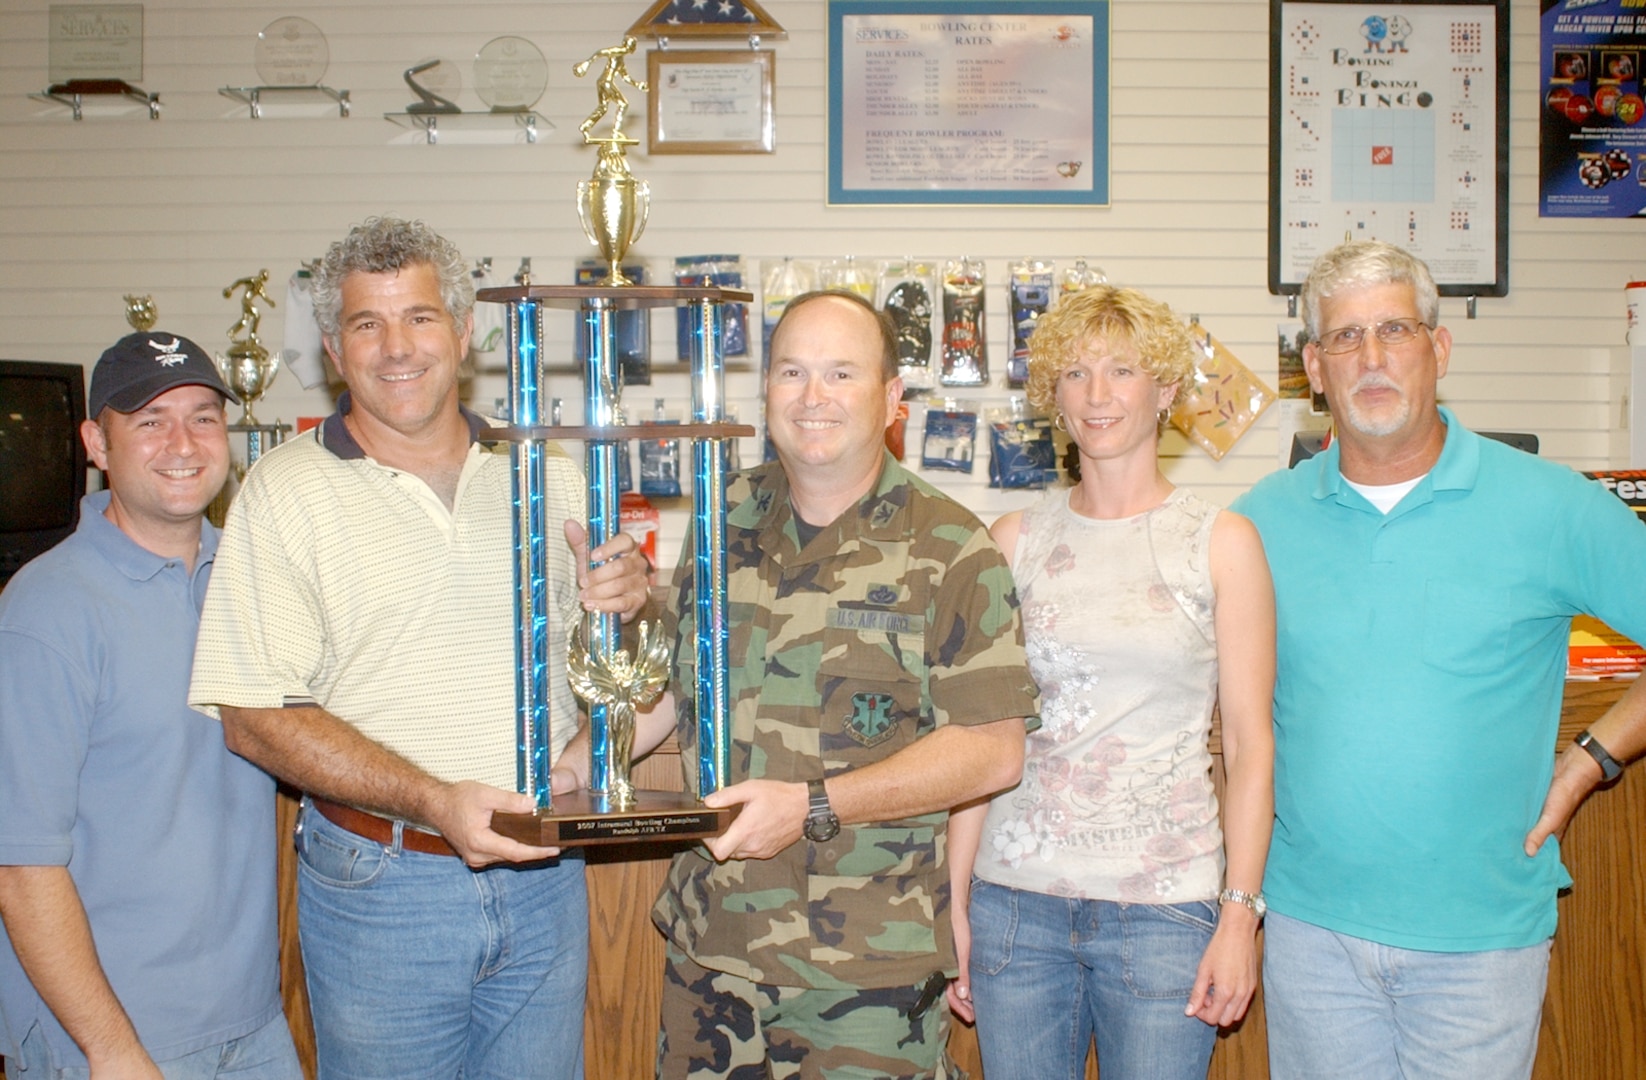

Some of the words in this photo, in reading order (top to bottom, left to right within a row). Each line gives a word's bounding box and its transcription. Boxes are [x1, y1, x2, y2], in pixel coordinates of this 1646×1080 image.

[920, 22, 976, 32] BOWLING
[980, 22, 1027, 32] CENTER
[856, 28, 909, 40] SERVICES
[955, 36, 993, 46] RATES
[1330, 48, 1394, 66] BOWLING
[1334, 88, 1434, 108] BINGO
[1620, 103, 1636, 114] 24
[837, 611, 856, 626] U.S.
[858, 612, 877, 630] AIR
[879, 614, 910, 632] FORCE
